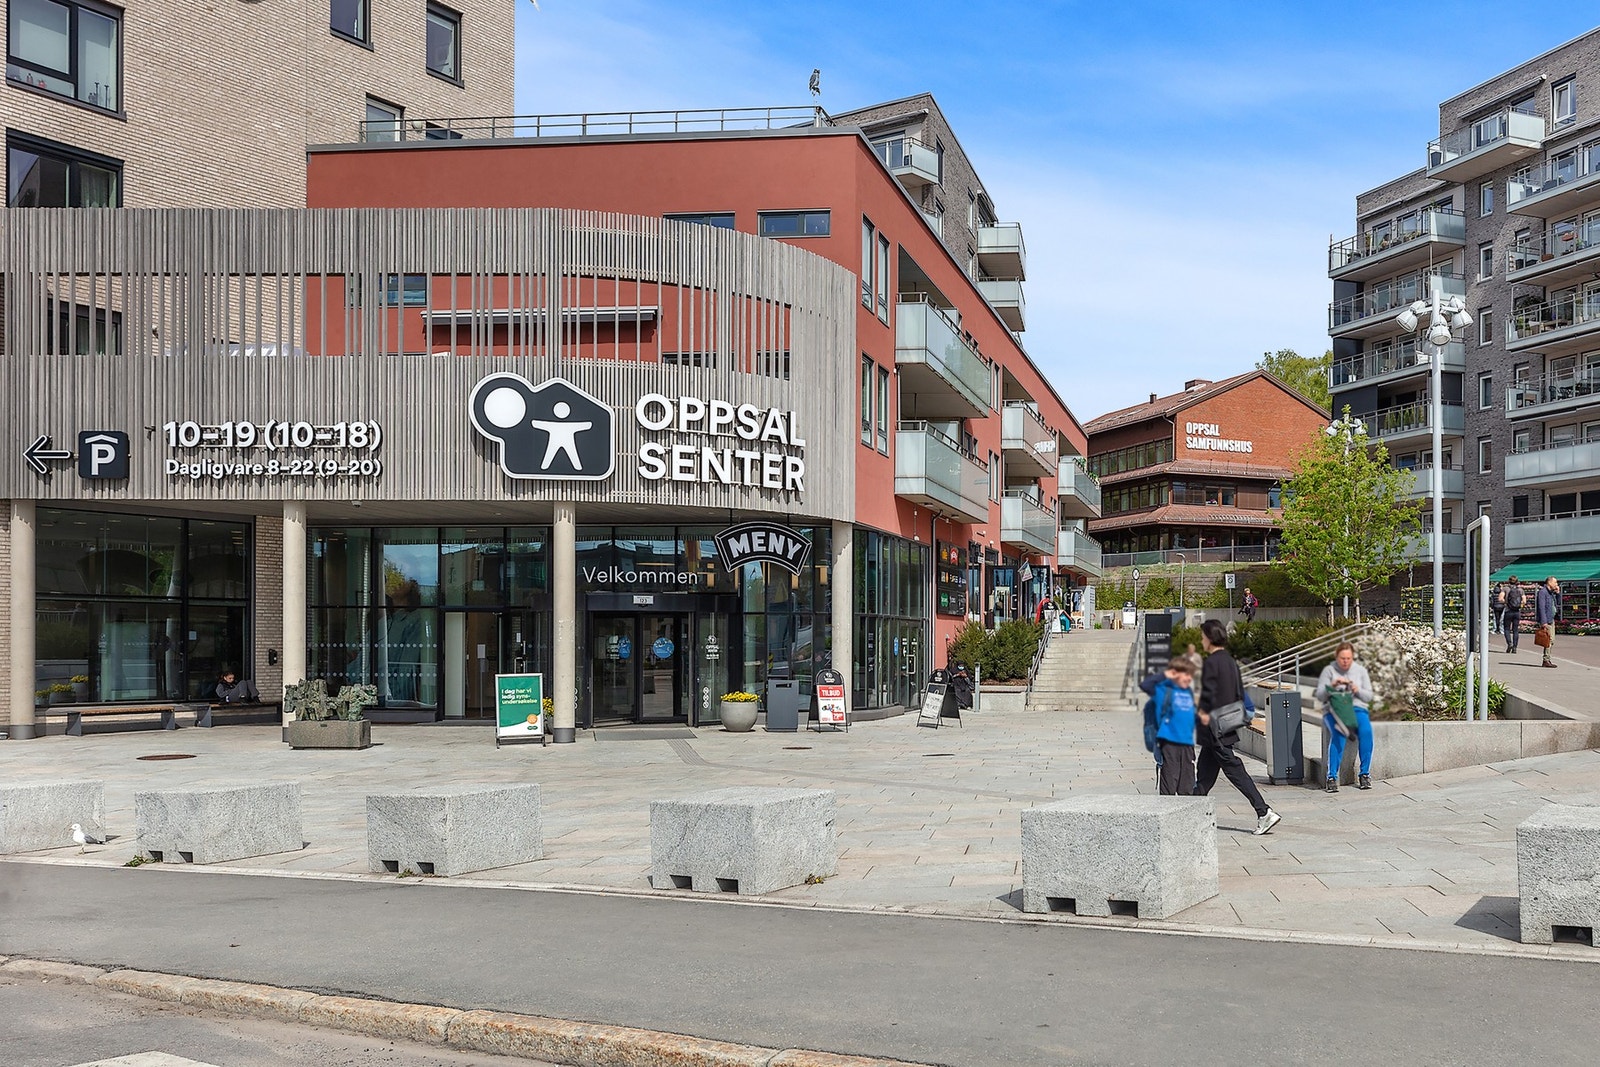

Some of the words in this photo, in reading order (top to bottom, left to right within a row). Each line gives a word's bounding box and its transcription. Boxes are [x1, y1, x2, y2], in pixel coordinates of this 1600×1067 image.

[635, 393, 806, 447] OPPSAL
[1186, 422, 1220, 436] OPPSAL
[1186, 436, 1253, 453] SAMFUNNSHUS
[91, 443, 116, 476] P
[166, 458, 264, 479] Dagligvare
[637, 442, 805, 491] SENTER
[727, 531, 802, 560] MENY
[582, 565, 698, 585] Velkommen
[821, 689, 841, 697] TILBUD
